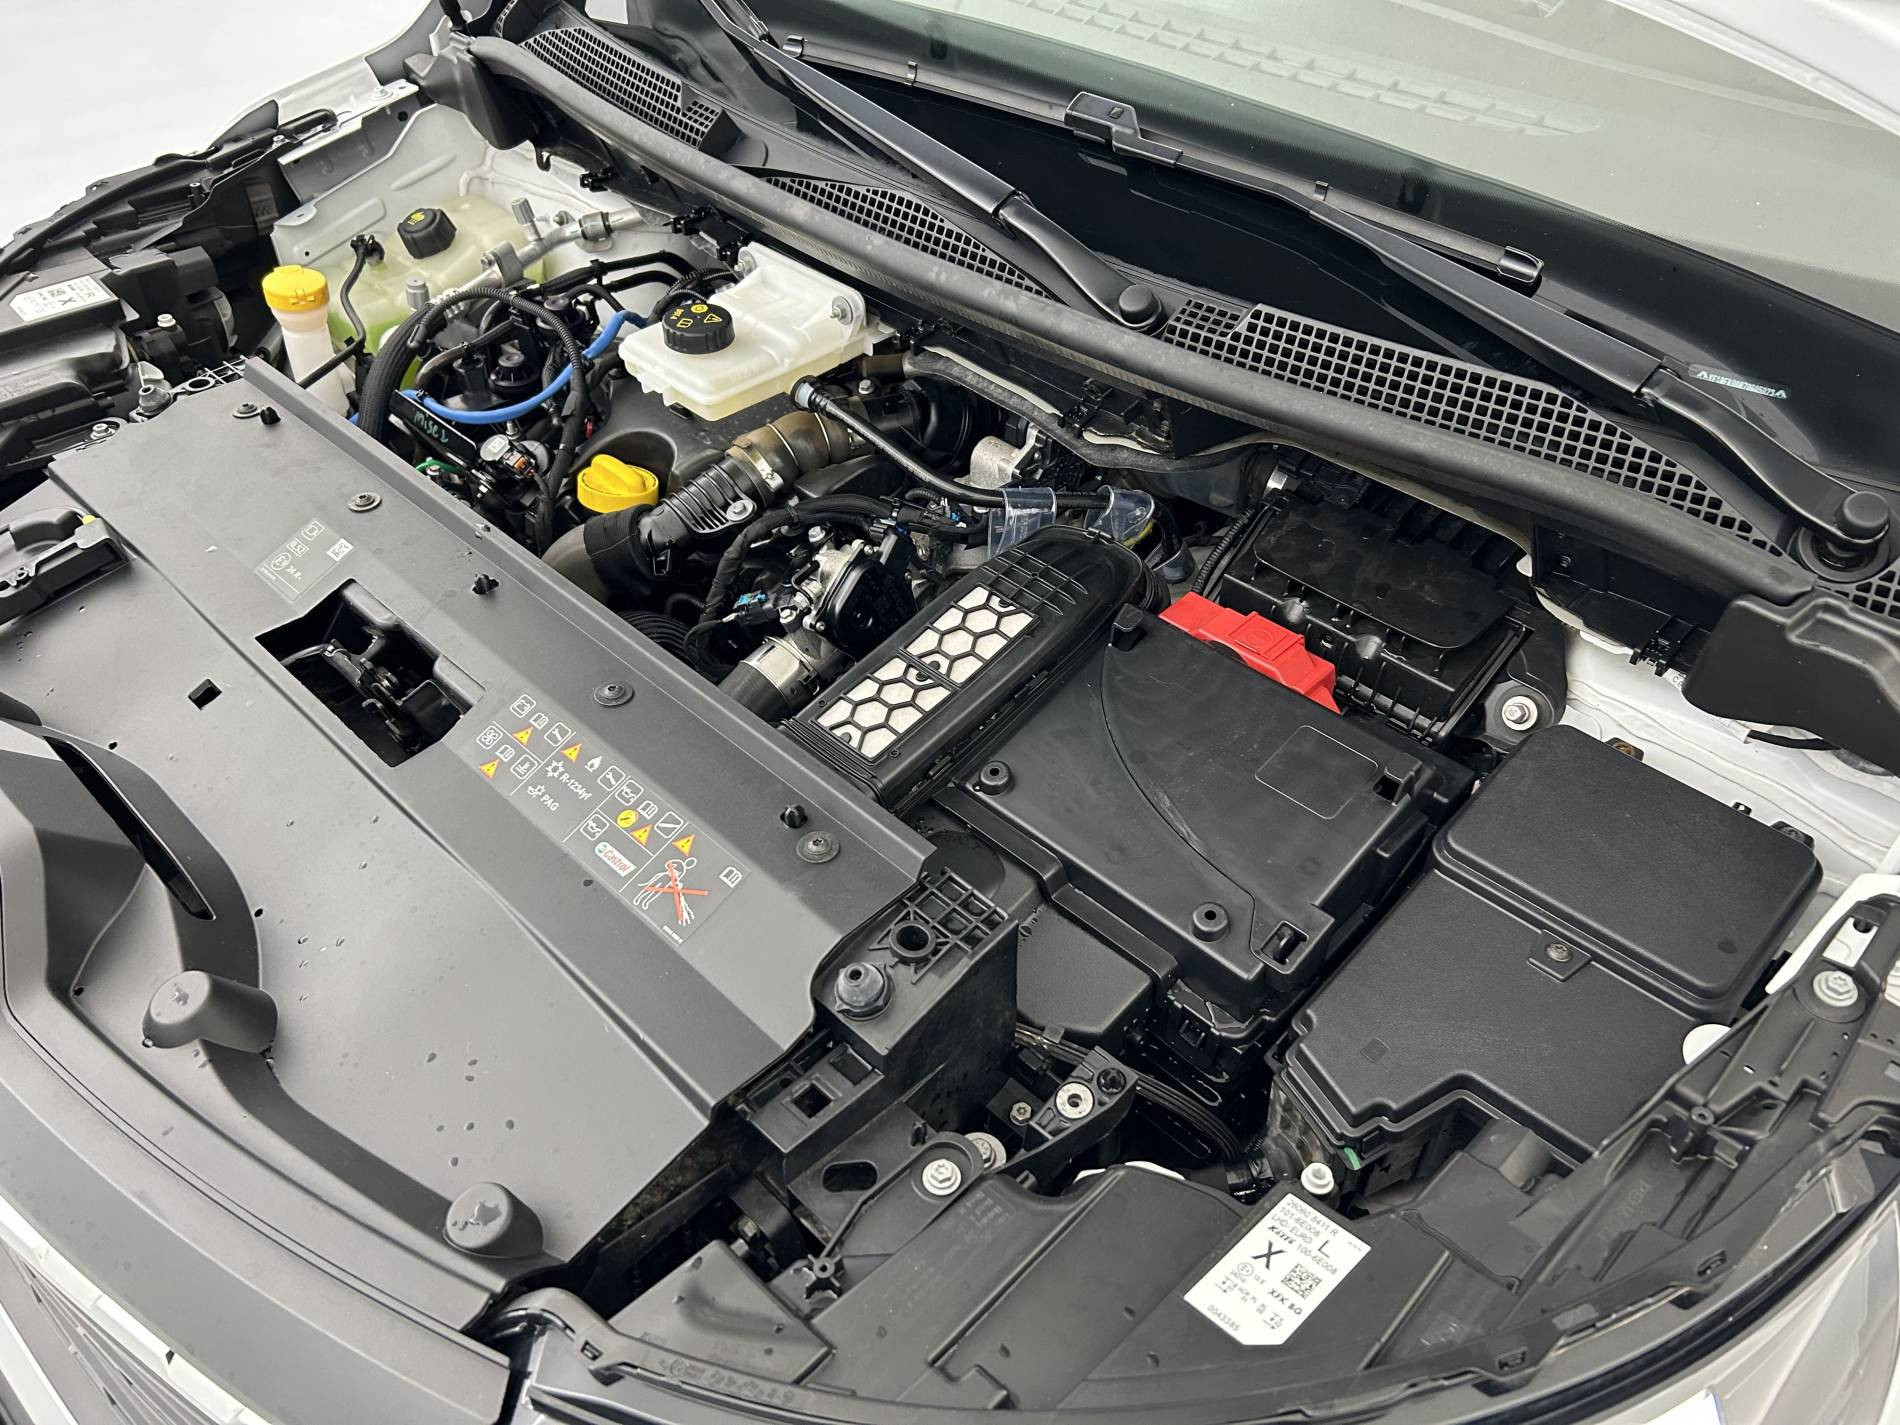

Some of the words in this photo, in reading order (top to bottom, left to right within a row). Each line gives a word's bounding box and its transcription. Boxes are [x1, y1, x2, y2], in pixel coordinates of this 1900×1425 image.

[540, 794, 560, 812] PAG
[603, 849, 632, 874] Castrol
[1250, 1240, 1287, 1270] X
[1318, 1240, 1331, 1258] L
